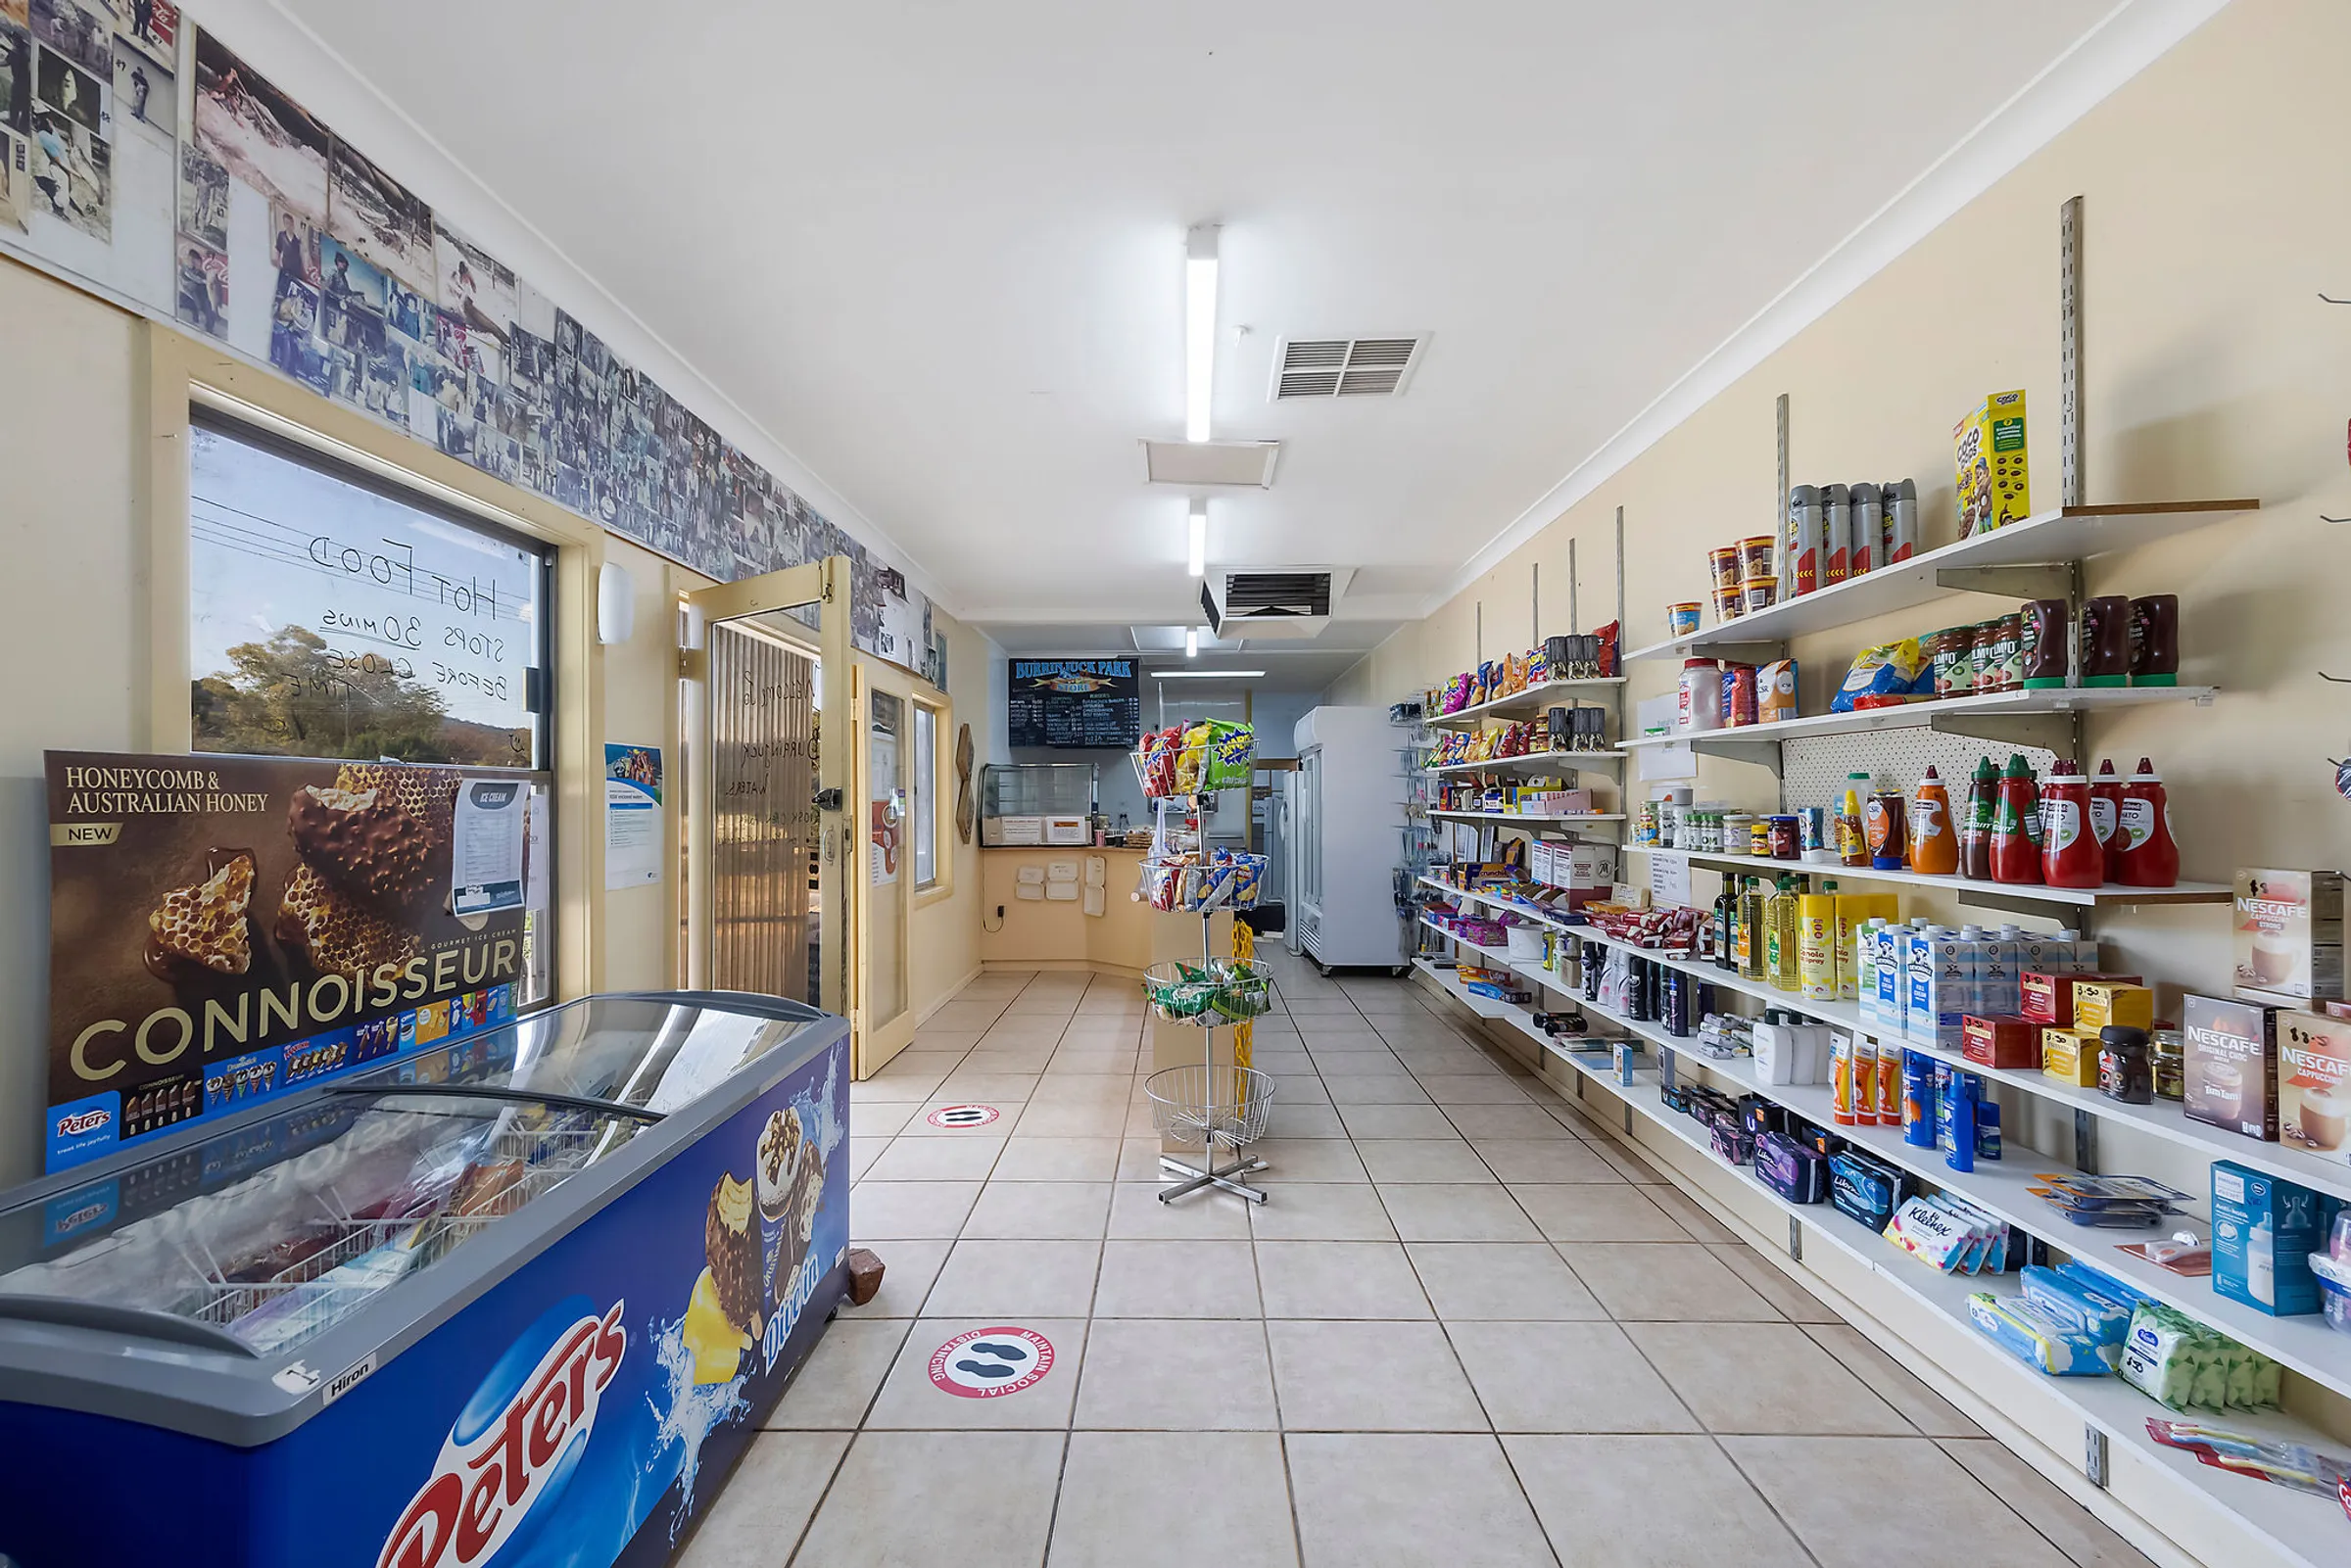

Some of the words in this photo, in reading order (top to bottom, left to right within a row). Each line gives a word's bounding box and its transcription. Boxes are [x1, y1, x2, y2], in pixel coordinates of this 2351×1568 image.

[1098, 661, 1131, 678] PARK
[66, 767, 204, 790] HONEYCOMB
[208, 772, 220, 789] &
[67, 792, 203, 814] AUSTRALIAN
[206, 793, 268, 813] HONEY
[68, 827, 113, 842] NEW
[431, 937, 470, 950] GOURMET
[492, 929, 516, 938] CREAM
[2078, 985, 2099, 996] 3.50
[69, 939, 517, 1082] CONNOISSEUR
[2198, 1044, 2228, 1057] ORIGINAL
[58, 1109, 111, 1137] Peters
[1834, 1176, 1860, 1197] Libra
[931, 1331, 981, 1381] DISTANCING
[1020, 1331, 1052, 1372] MAINTAIN
[331, 1363, 368, 1398] Hiron
[978, 1373, 1038, 1397] SOCIAL
[377, 1299, 627, 1568] Peters
